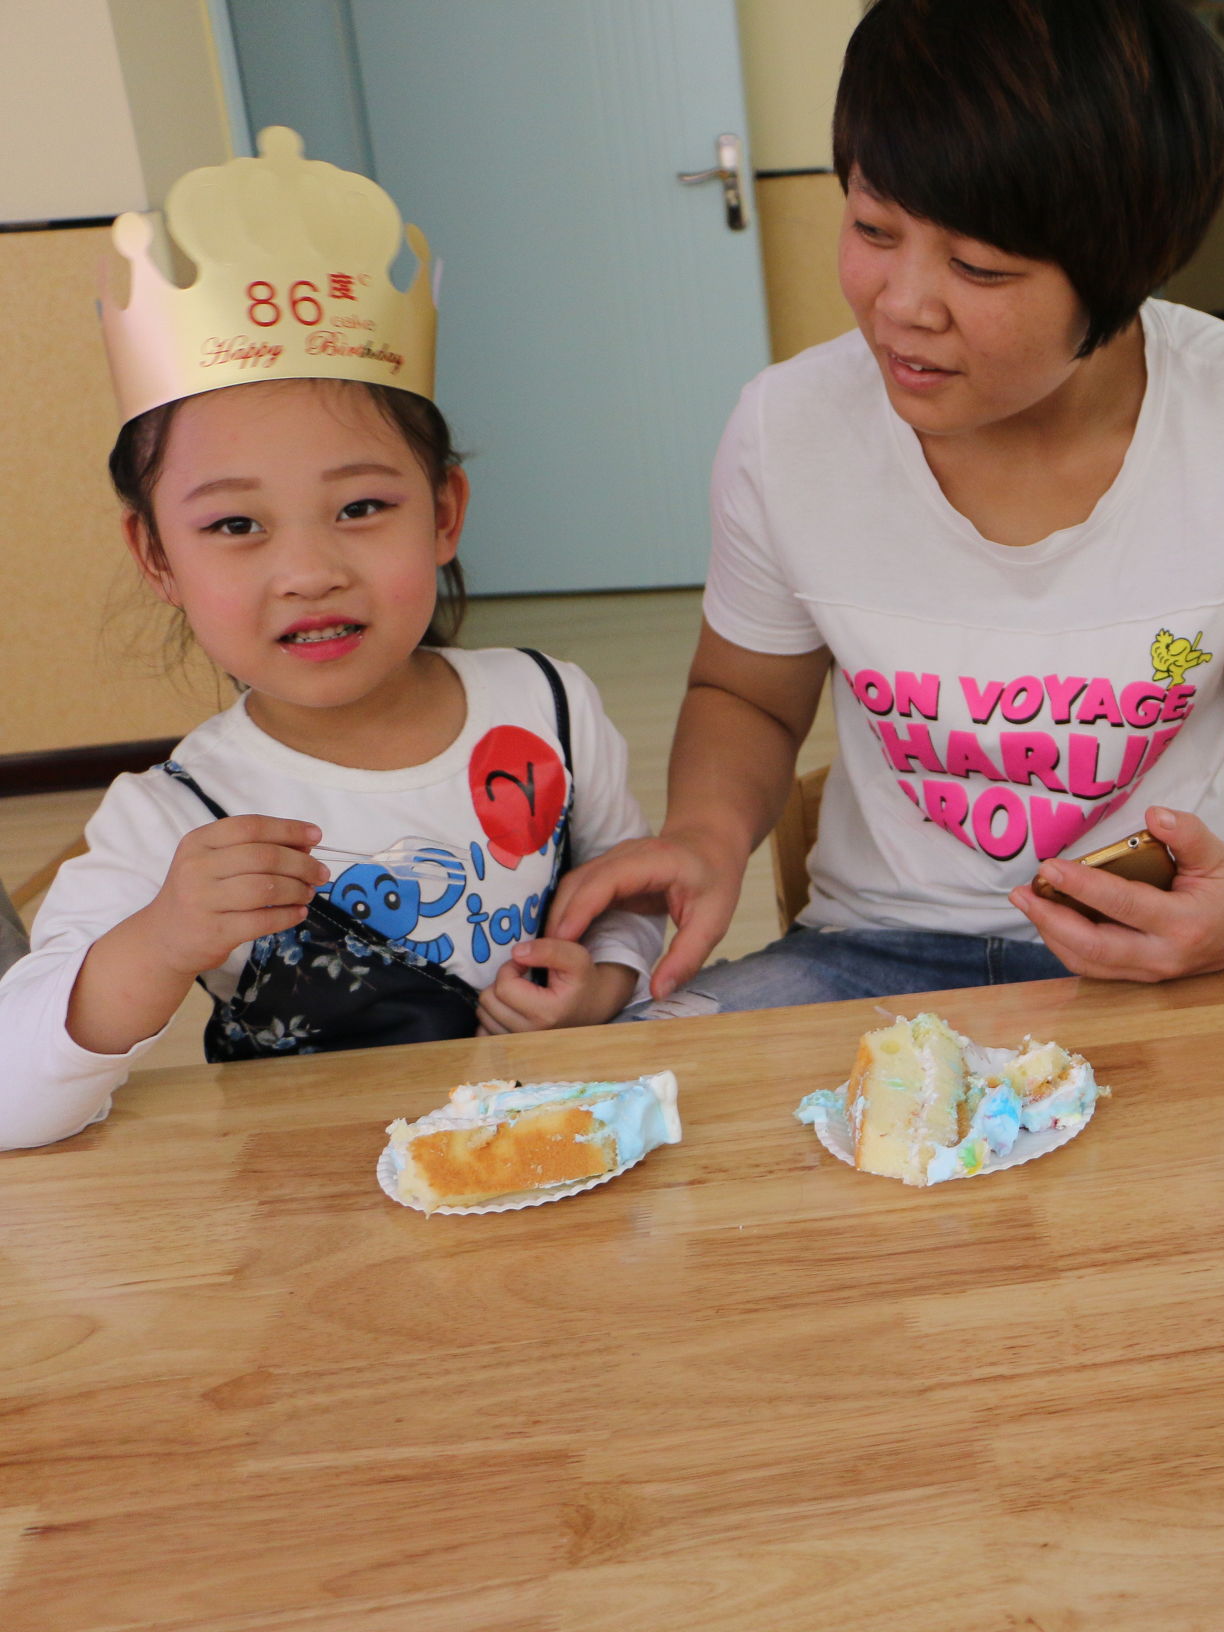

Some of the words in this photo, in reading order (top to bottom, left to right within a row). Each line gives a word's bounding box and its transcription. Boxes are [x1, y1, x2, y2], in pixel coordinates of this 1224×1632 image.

[200, 334, 284, 369] Happy
[841, 668, 941, 721] ON
[897, 777, 1144, 861] ROW
